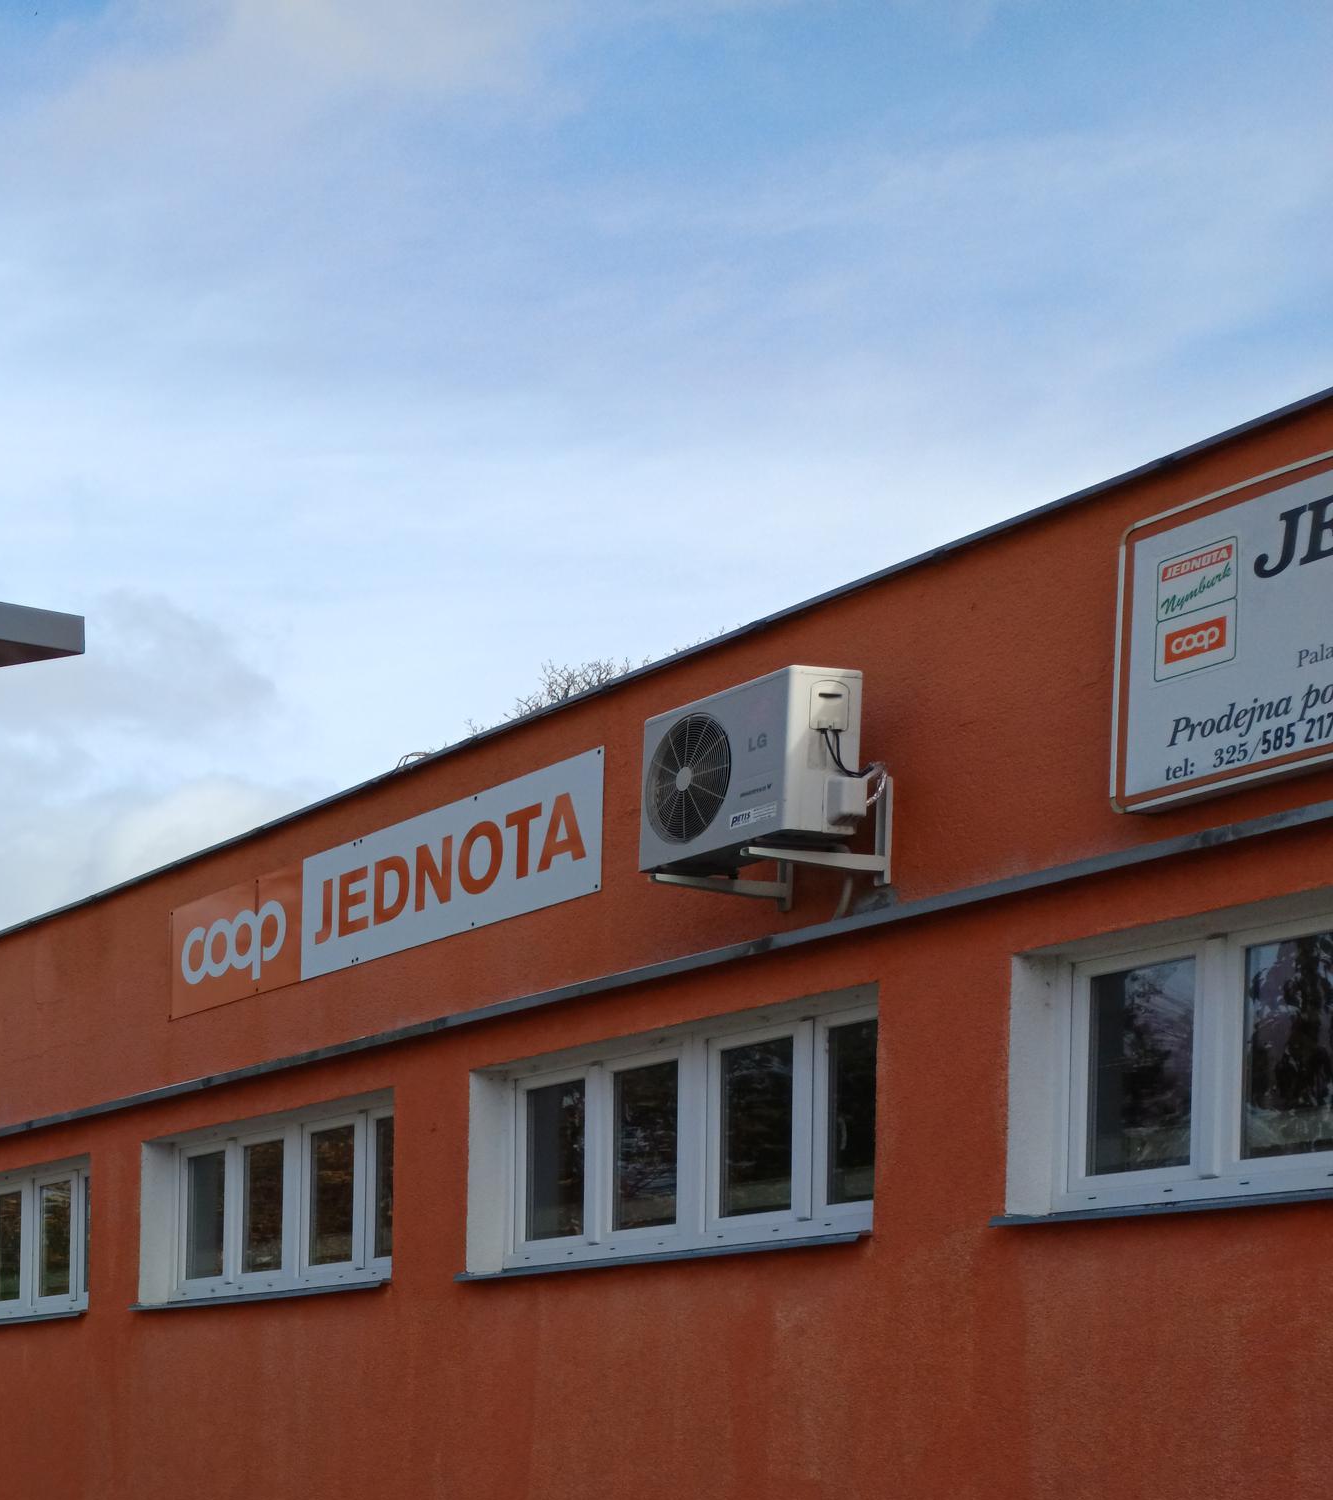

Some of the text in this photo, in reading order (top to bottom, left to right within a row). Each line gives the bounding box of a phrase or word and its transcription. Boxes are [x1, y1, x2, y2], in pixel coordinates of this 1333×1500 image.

[1165, 548, 1229, 580] JEDNOTA
[1161, 562, 1231, 614] Nymburk
[1171, 626, 1221, 655] coop
[1297, 643, 1333, 668] Pala
[1167, 698, 1293, 747] Prodejna
[748, 733, 768, 753] LG
[1165, 758, 1195, 781] tel:
[1213, 722, 1296, 768] 325/585
[181, 792, 587, 985] coop JEDNOTA
